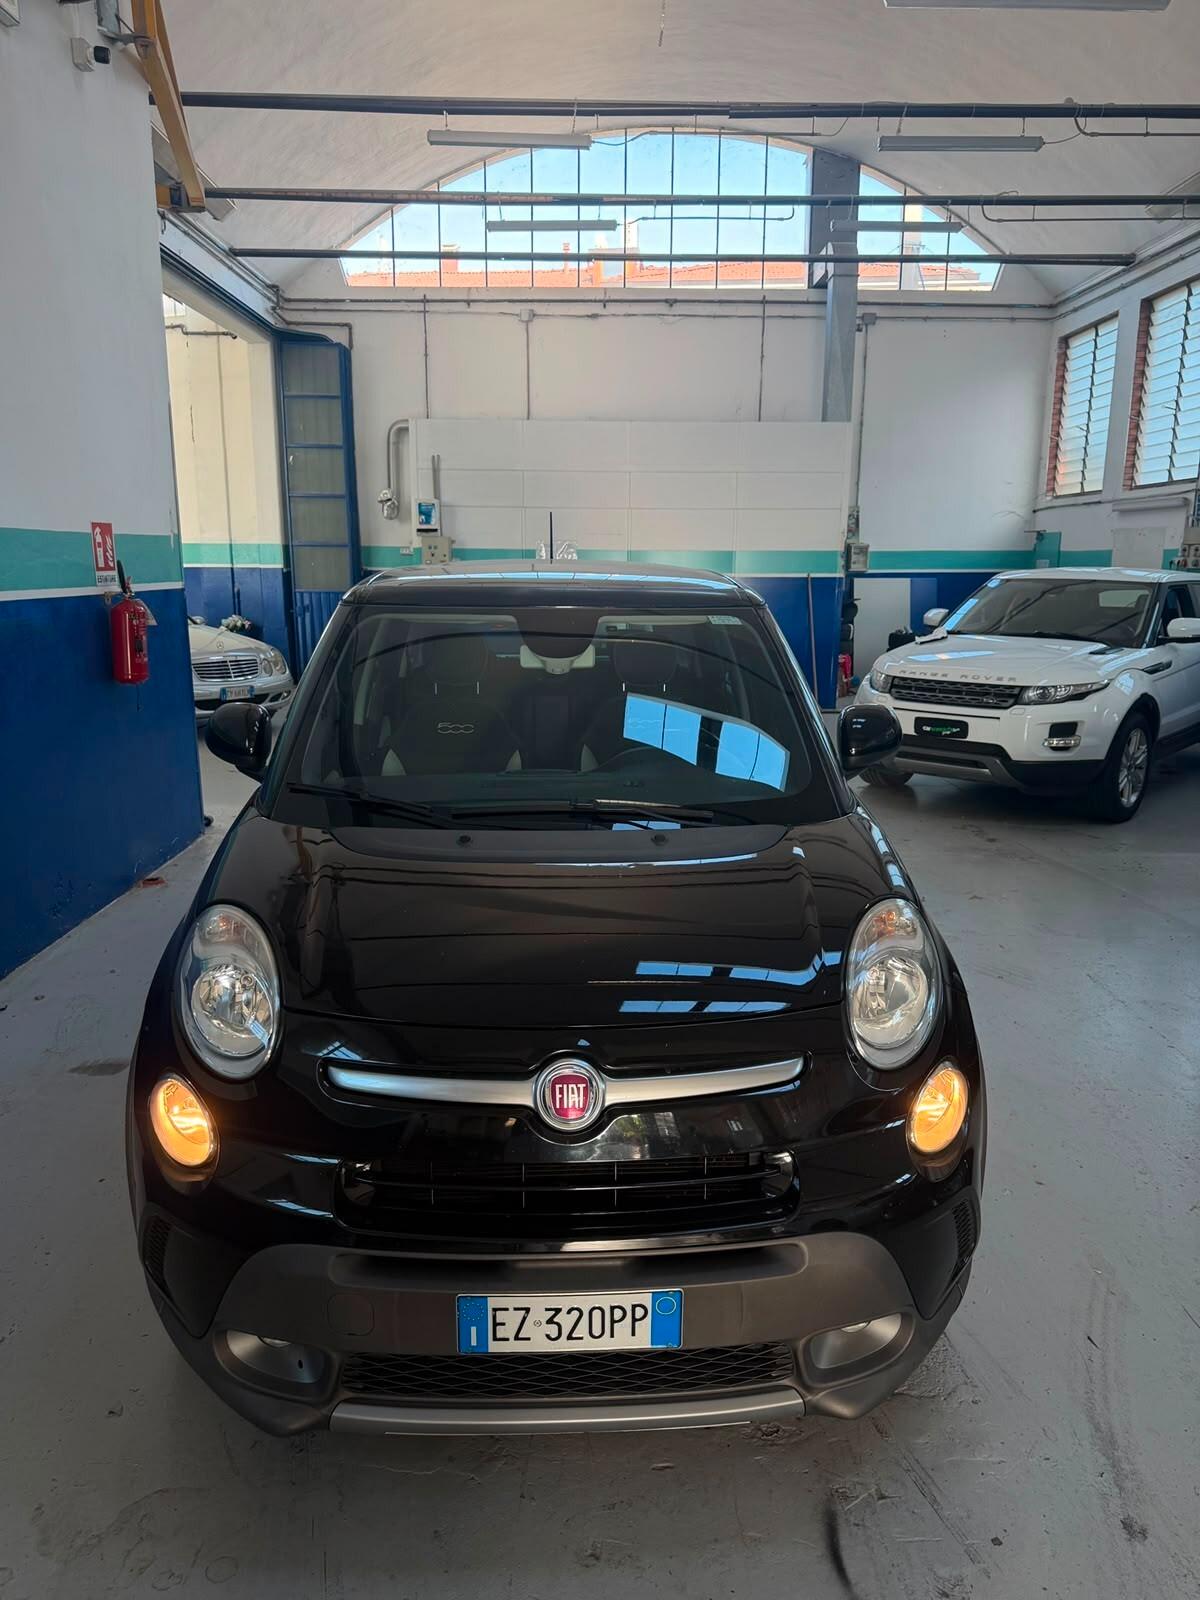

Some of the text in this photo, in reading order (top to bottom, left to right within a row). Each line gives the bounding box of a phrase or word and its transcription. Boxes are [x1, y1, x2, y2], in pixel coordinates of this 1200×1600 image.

[960, 674, 1017, 682] ROVER
[438, 722, 474, 734] 500
[555, 1084, 586, 1109] FIAT
[492, 1303, 648, 1341] EZ 320PP
